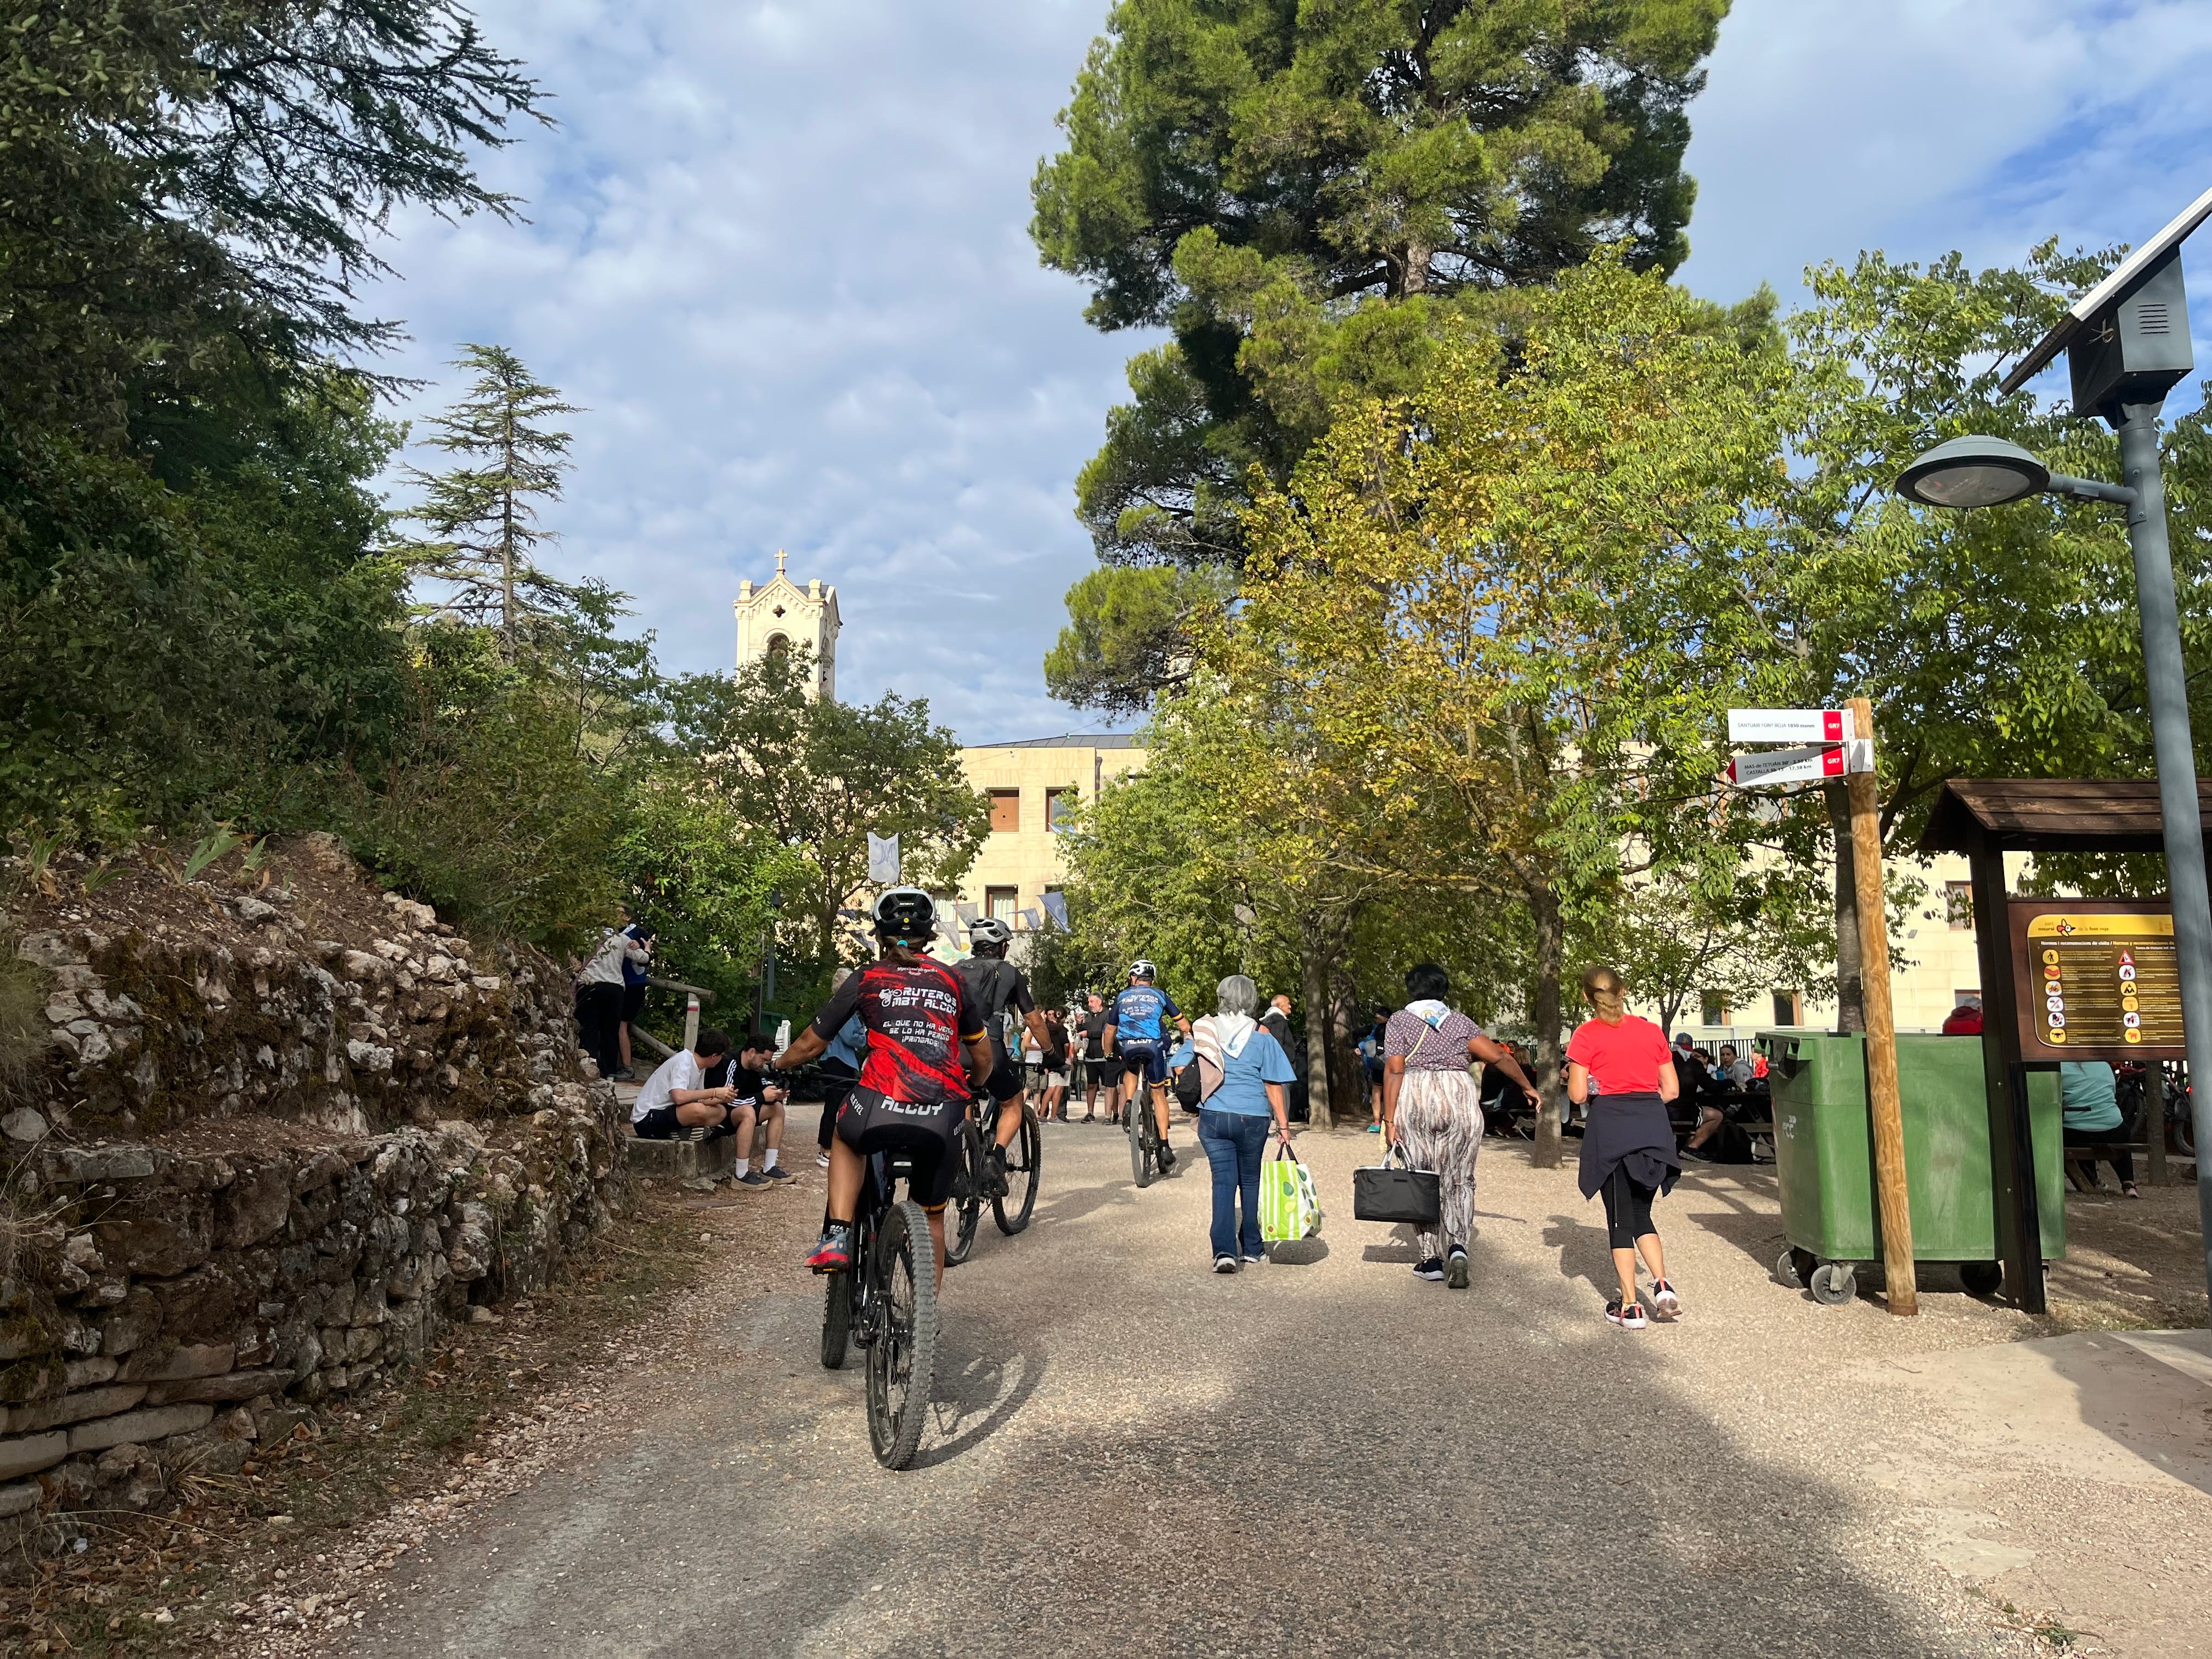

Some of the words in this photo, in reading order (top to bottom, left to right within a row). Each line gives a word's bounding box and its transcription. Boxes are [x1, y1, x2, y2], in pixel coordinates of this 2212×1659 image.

[891, 997, 919, 1007] MBT
[924, 998, 957, 1016] ALCOY
[902, 987, 957, 1007] RUTEROS
[881, 1095, 944, 1116] ALCOY
